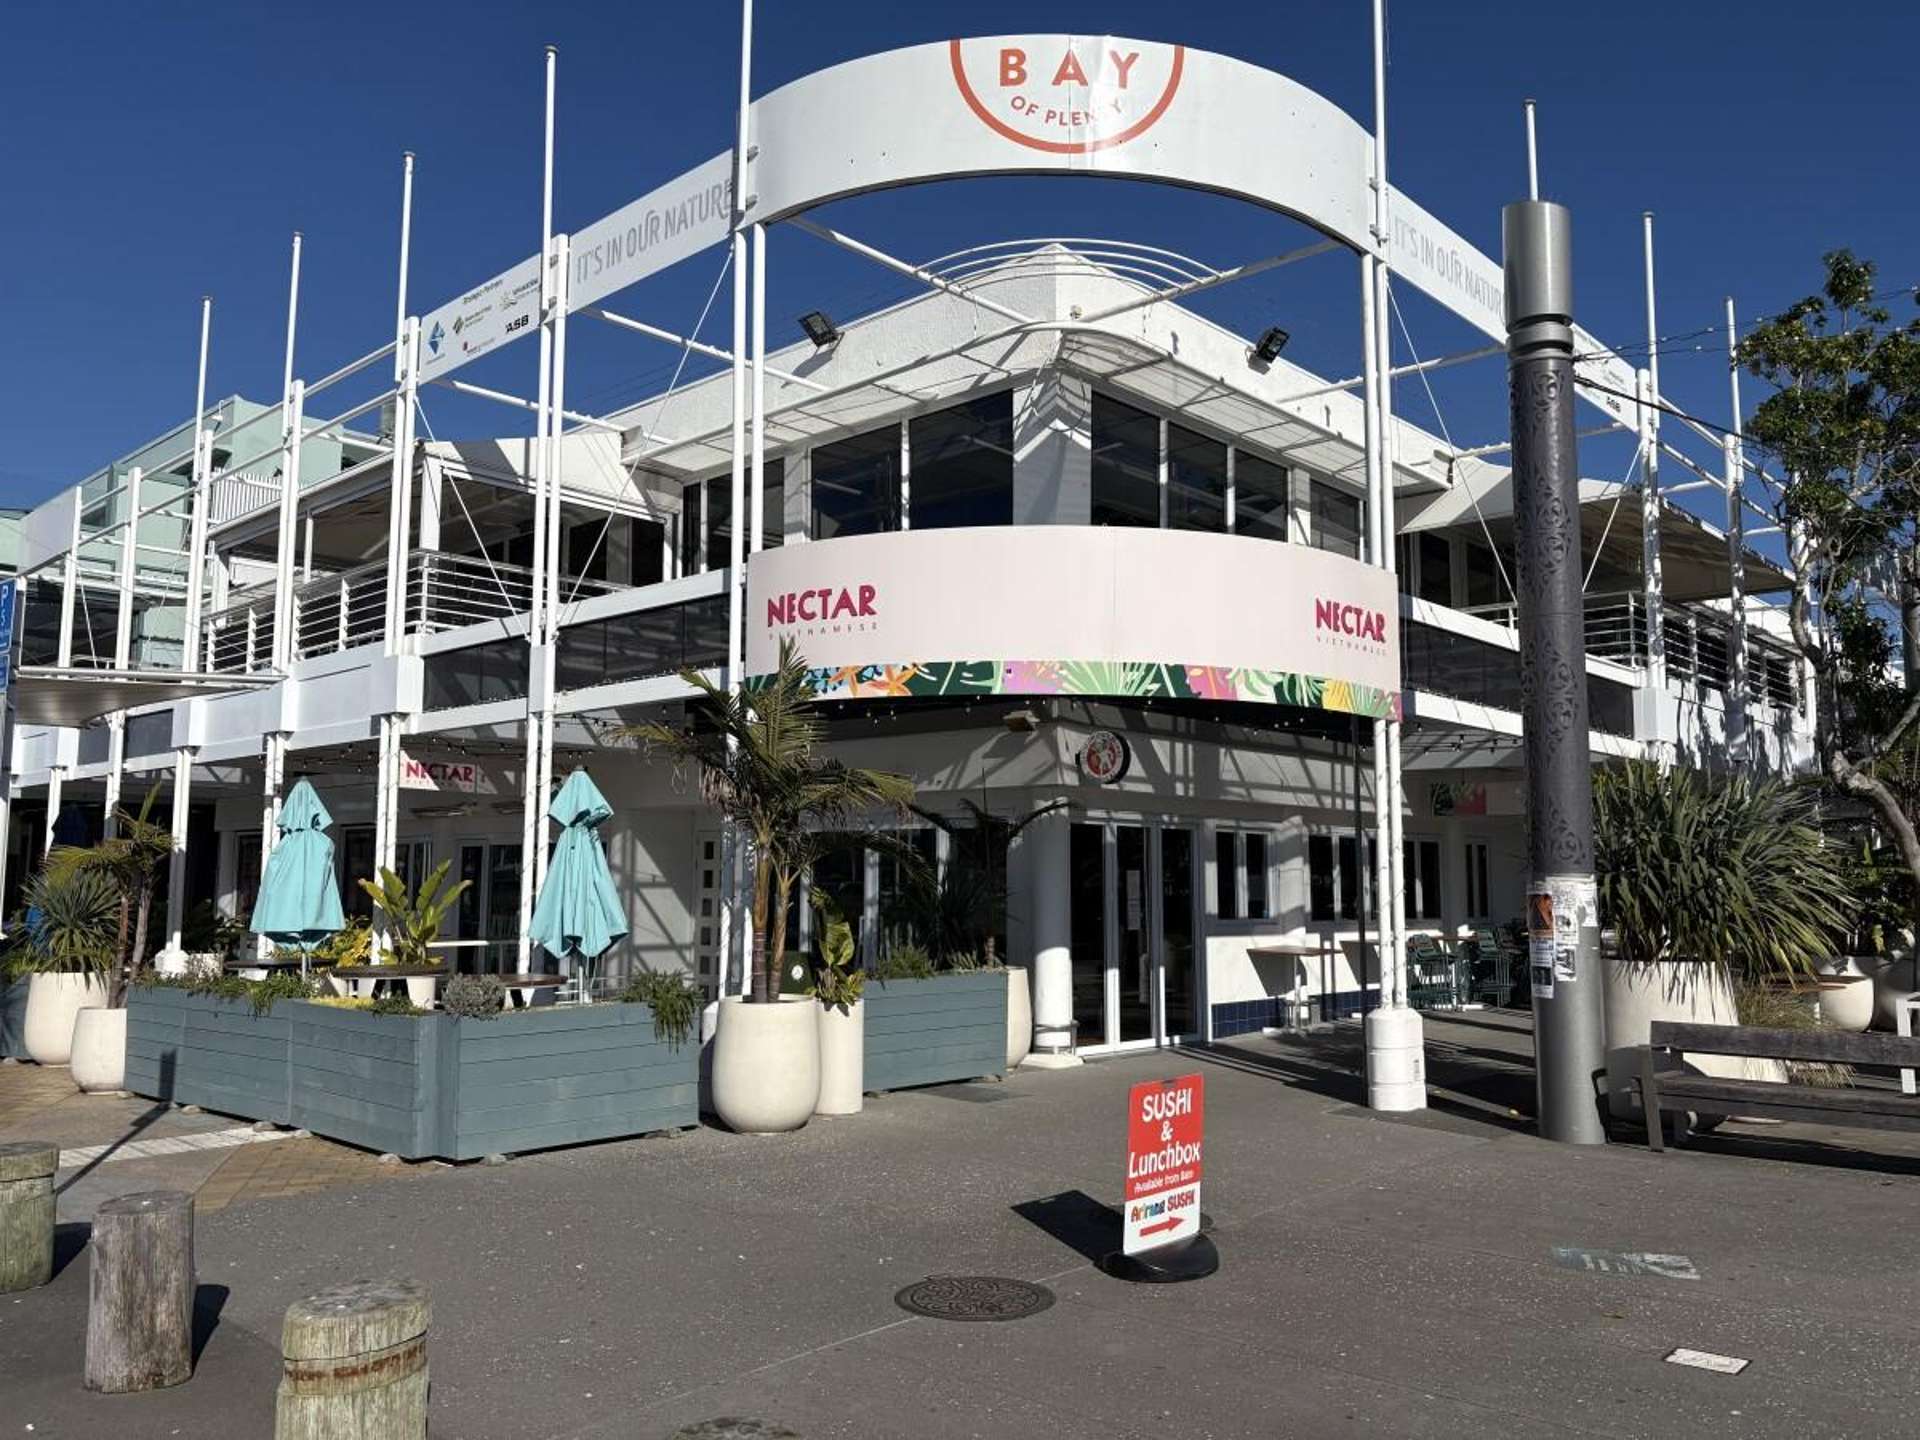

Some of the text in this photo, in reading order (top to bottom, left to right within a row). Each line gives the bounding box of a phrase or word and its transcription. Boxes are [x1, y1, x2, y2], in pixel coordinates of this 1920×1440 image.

[1000, 48, 1140, 89] BAY
[1010, 95, 1121, 126] OF PLENY
[577, 178, 732, 284] IT'S IN OUR NATURE
[1420, 233, 1434, 270] IN
[1437, 248, 1462, 289] OUR
[1464, 265, 1505, 326] NATUR
[505, 314, 529, 334] ASB
[768, 584, 878, 627] NECTAR
[1315, 597, 1386, 643] NECTAR
[768, 621, 878, 640] VETNAMESE
[406, 761, 473, 782] NECTAR
[1142, 1088, 1192, 1123] SUSHI
[1161, 1120, 1173, 1142] &
[1128, 1141, 1200, 1179] Lunchbox
